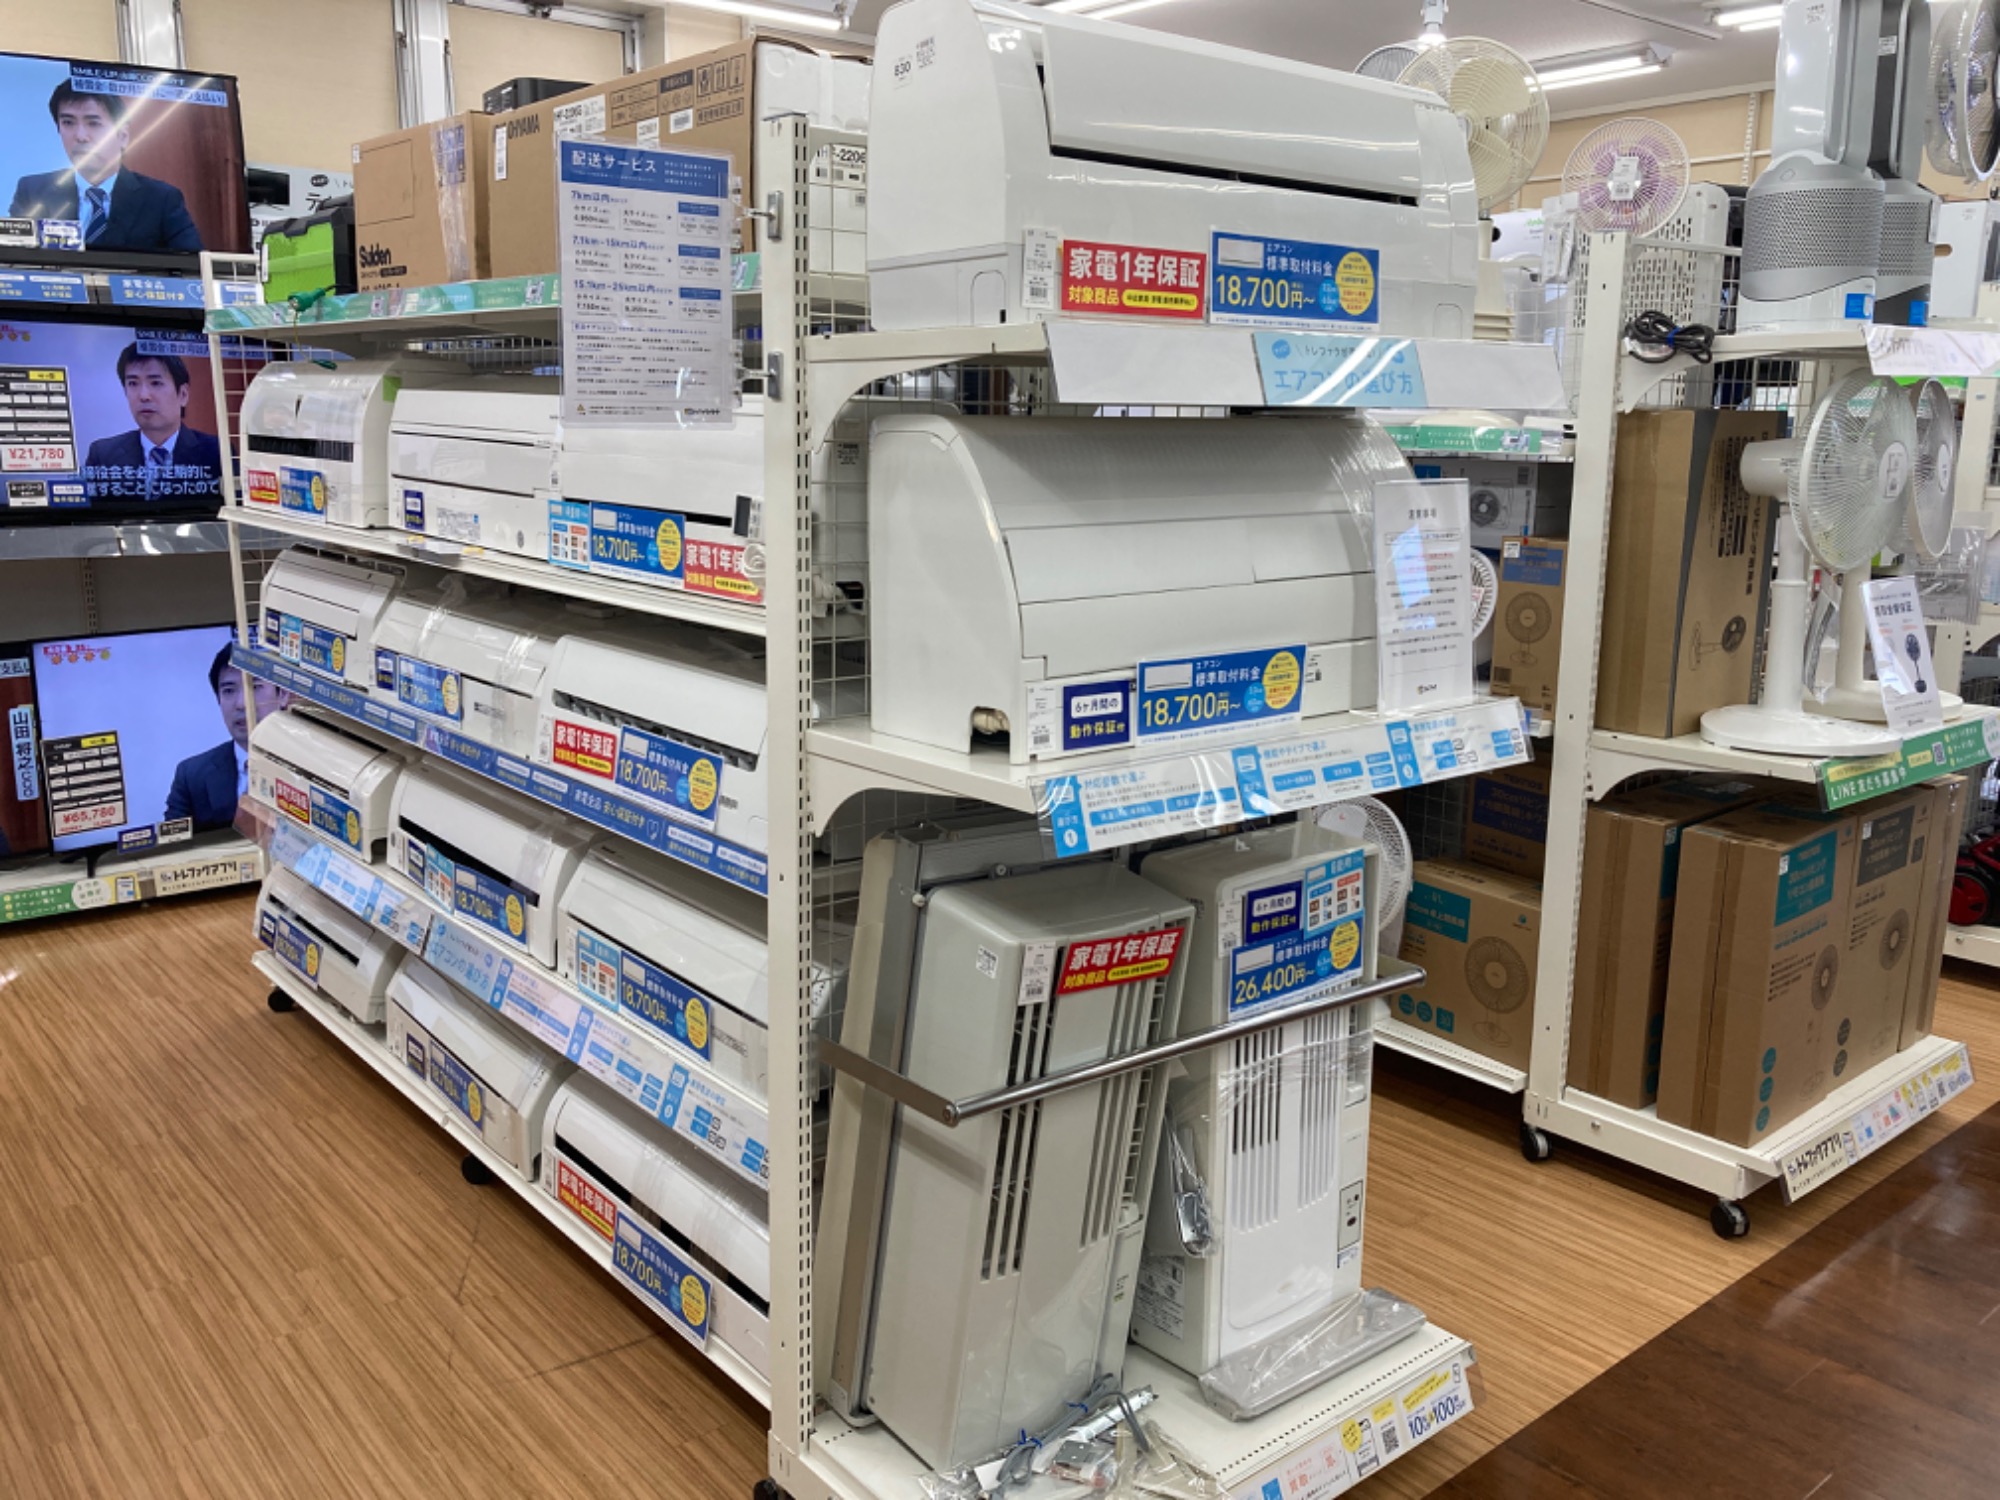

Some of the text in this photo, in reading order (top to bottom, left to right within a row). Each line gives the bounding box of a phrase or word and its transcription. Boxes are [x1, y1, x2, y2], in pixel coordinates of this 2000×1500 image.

[571, 150, 657, 173] 配送サービス
[1266, 243, 1294, 253] エアコン
[1069, 246, 1201, 289] 家電1年保証
[1266, 257, 1333, 277] 標準取付料金
[1068, 285, 1120, 306] 対象商品
[1274, 369, 1413, 396] エアコの選び方
[9, 448, 65, 460] ¥21,780
[685, 543, 747, 574] 家電1年保
[1195, 665, 1260, 688] 標準取付料金
[1075, 696, 1119, 713] 6ヶ月間の
[13, 711, 30, 740] 山田
[1069, 720, 1125, 739] 動作保証付
[556, 724, 614, 759] 家電1年保証
[62, 805, 116, 824] ¥65,780
[1069, 932, 1180, 971] 家電1年保証
[1275, 937, 1329, 963] 標準取付料金
[560, 1165, 614, 1224] 家電1年保証
